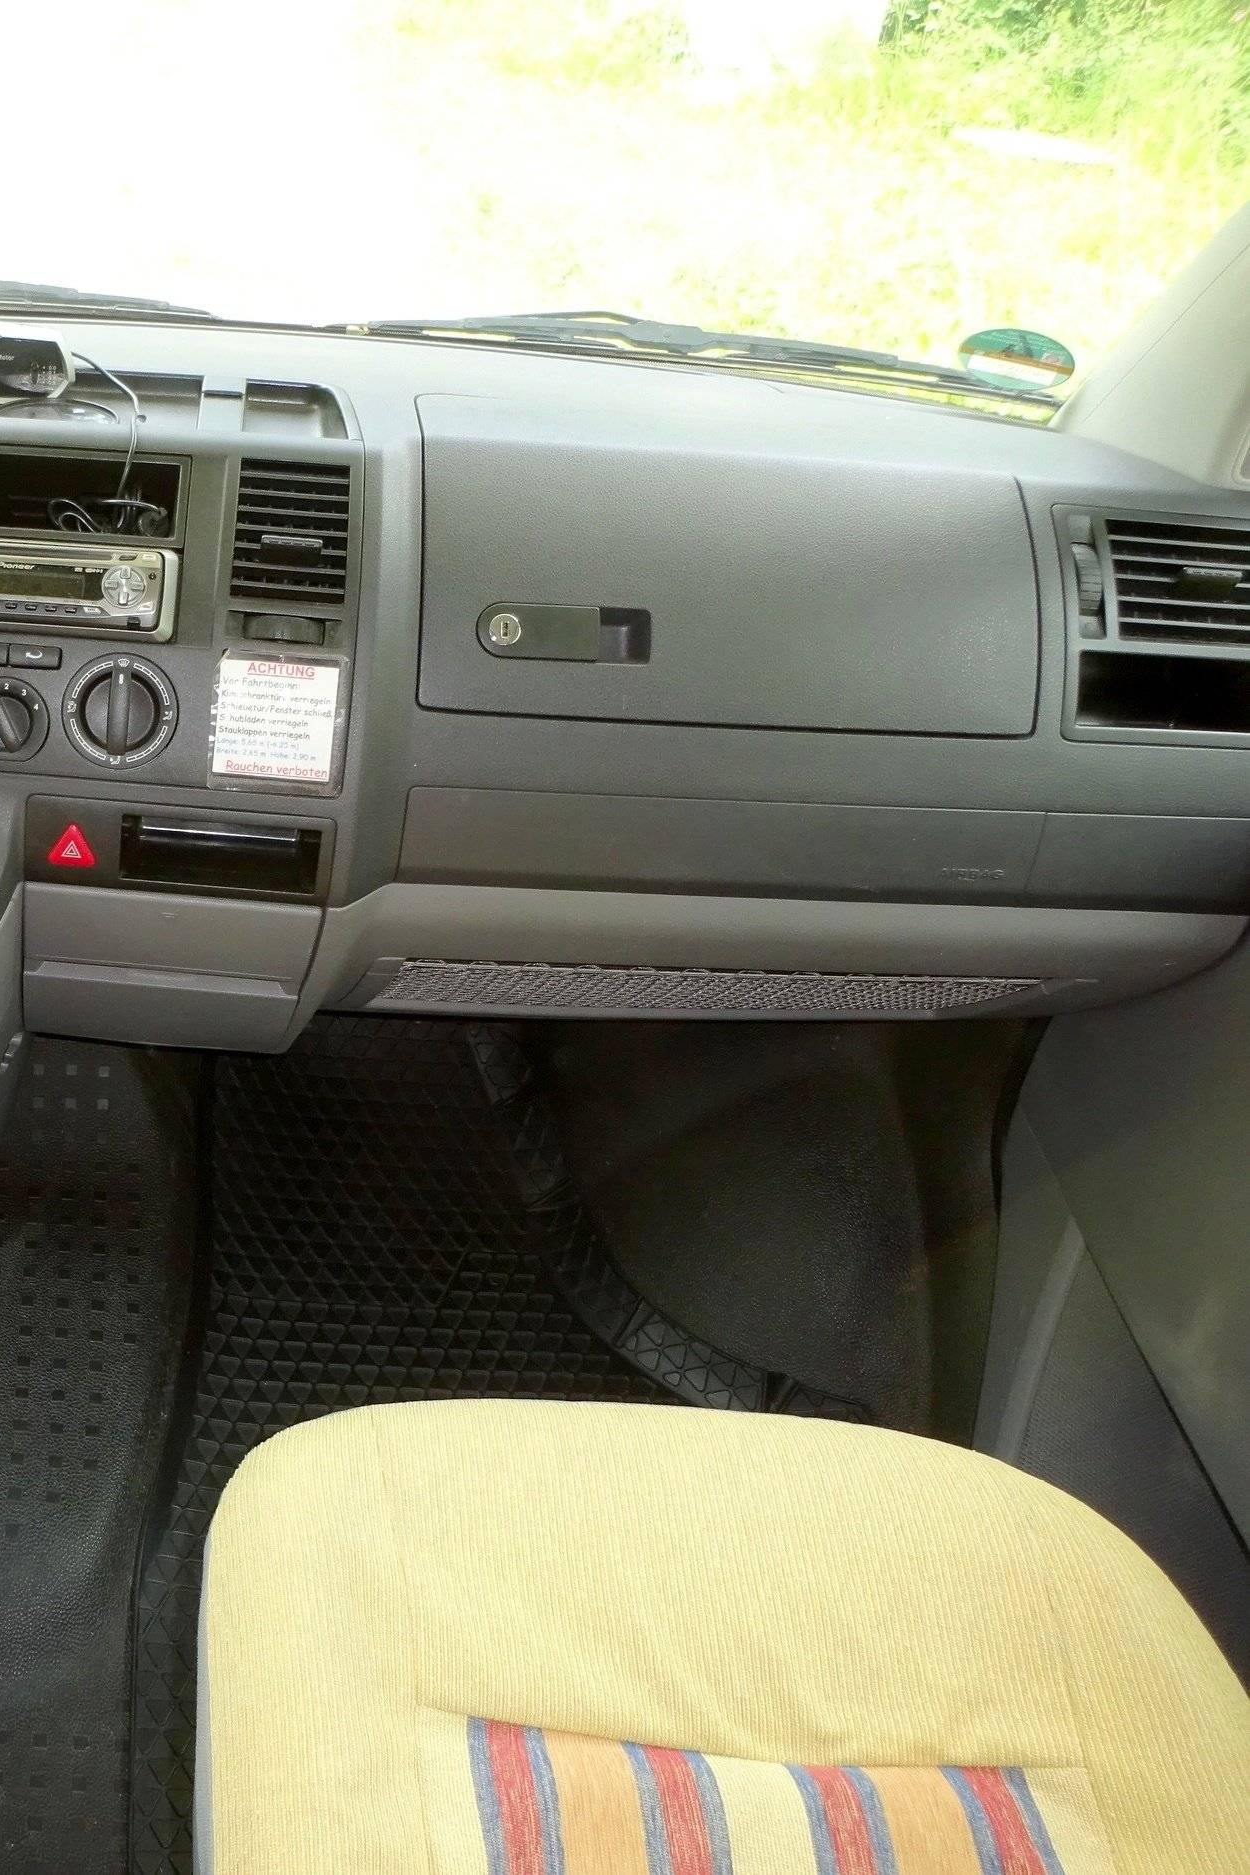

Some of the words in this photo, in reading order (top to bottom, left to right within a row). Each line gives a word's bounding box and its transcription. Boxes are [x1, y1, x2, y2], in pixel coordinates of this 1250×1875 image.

[247, 662, 316, 678] ACHTUNG
[223, 676, 239, 685] Vor
[33, 703, 39, 711] 4
[268, 719, 309, 729] verriegeln
[218, 726, 268, 737] Stauklappen
[269, 731, 310, 740] verriegeln
[225, 759, 273, 773] Rauchen
[276, 763, 328, 778] verboten
